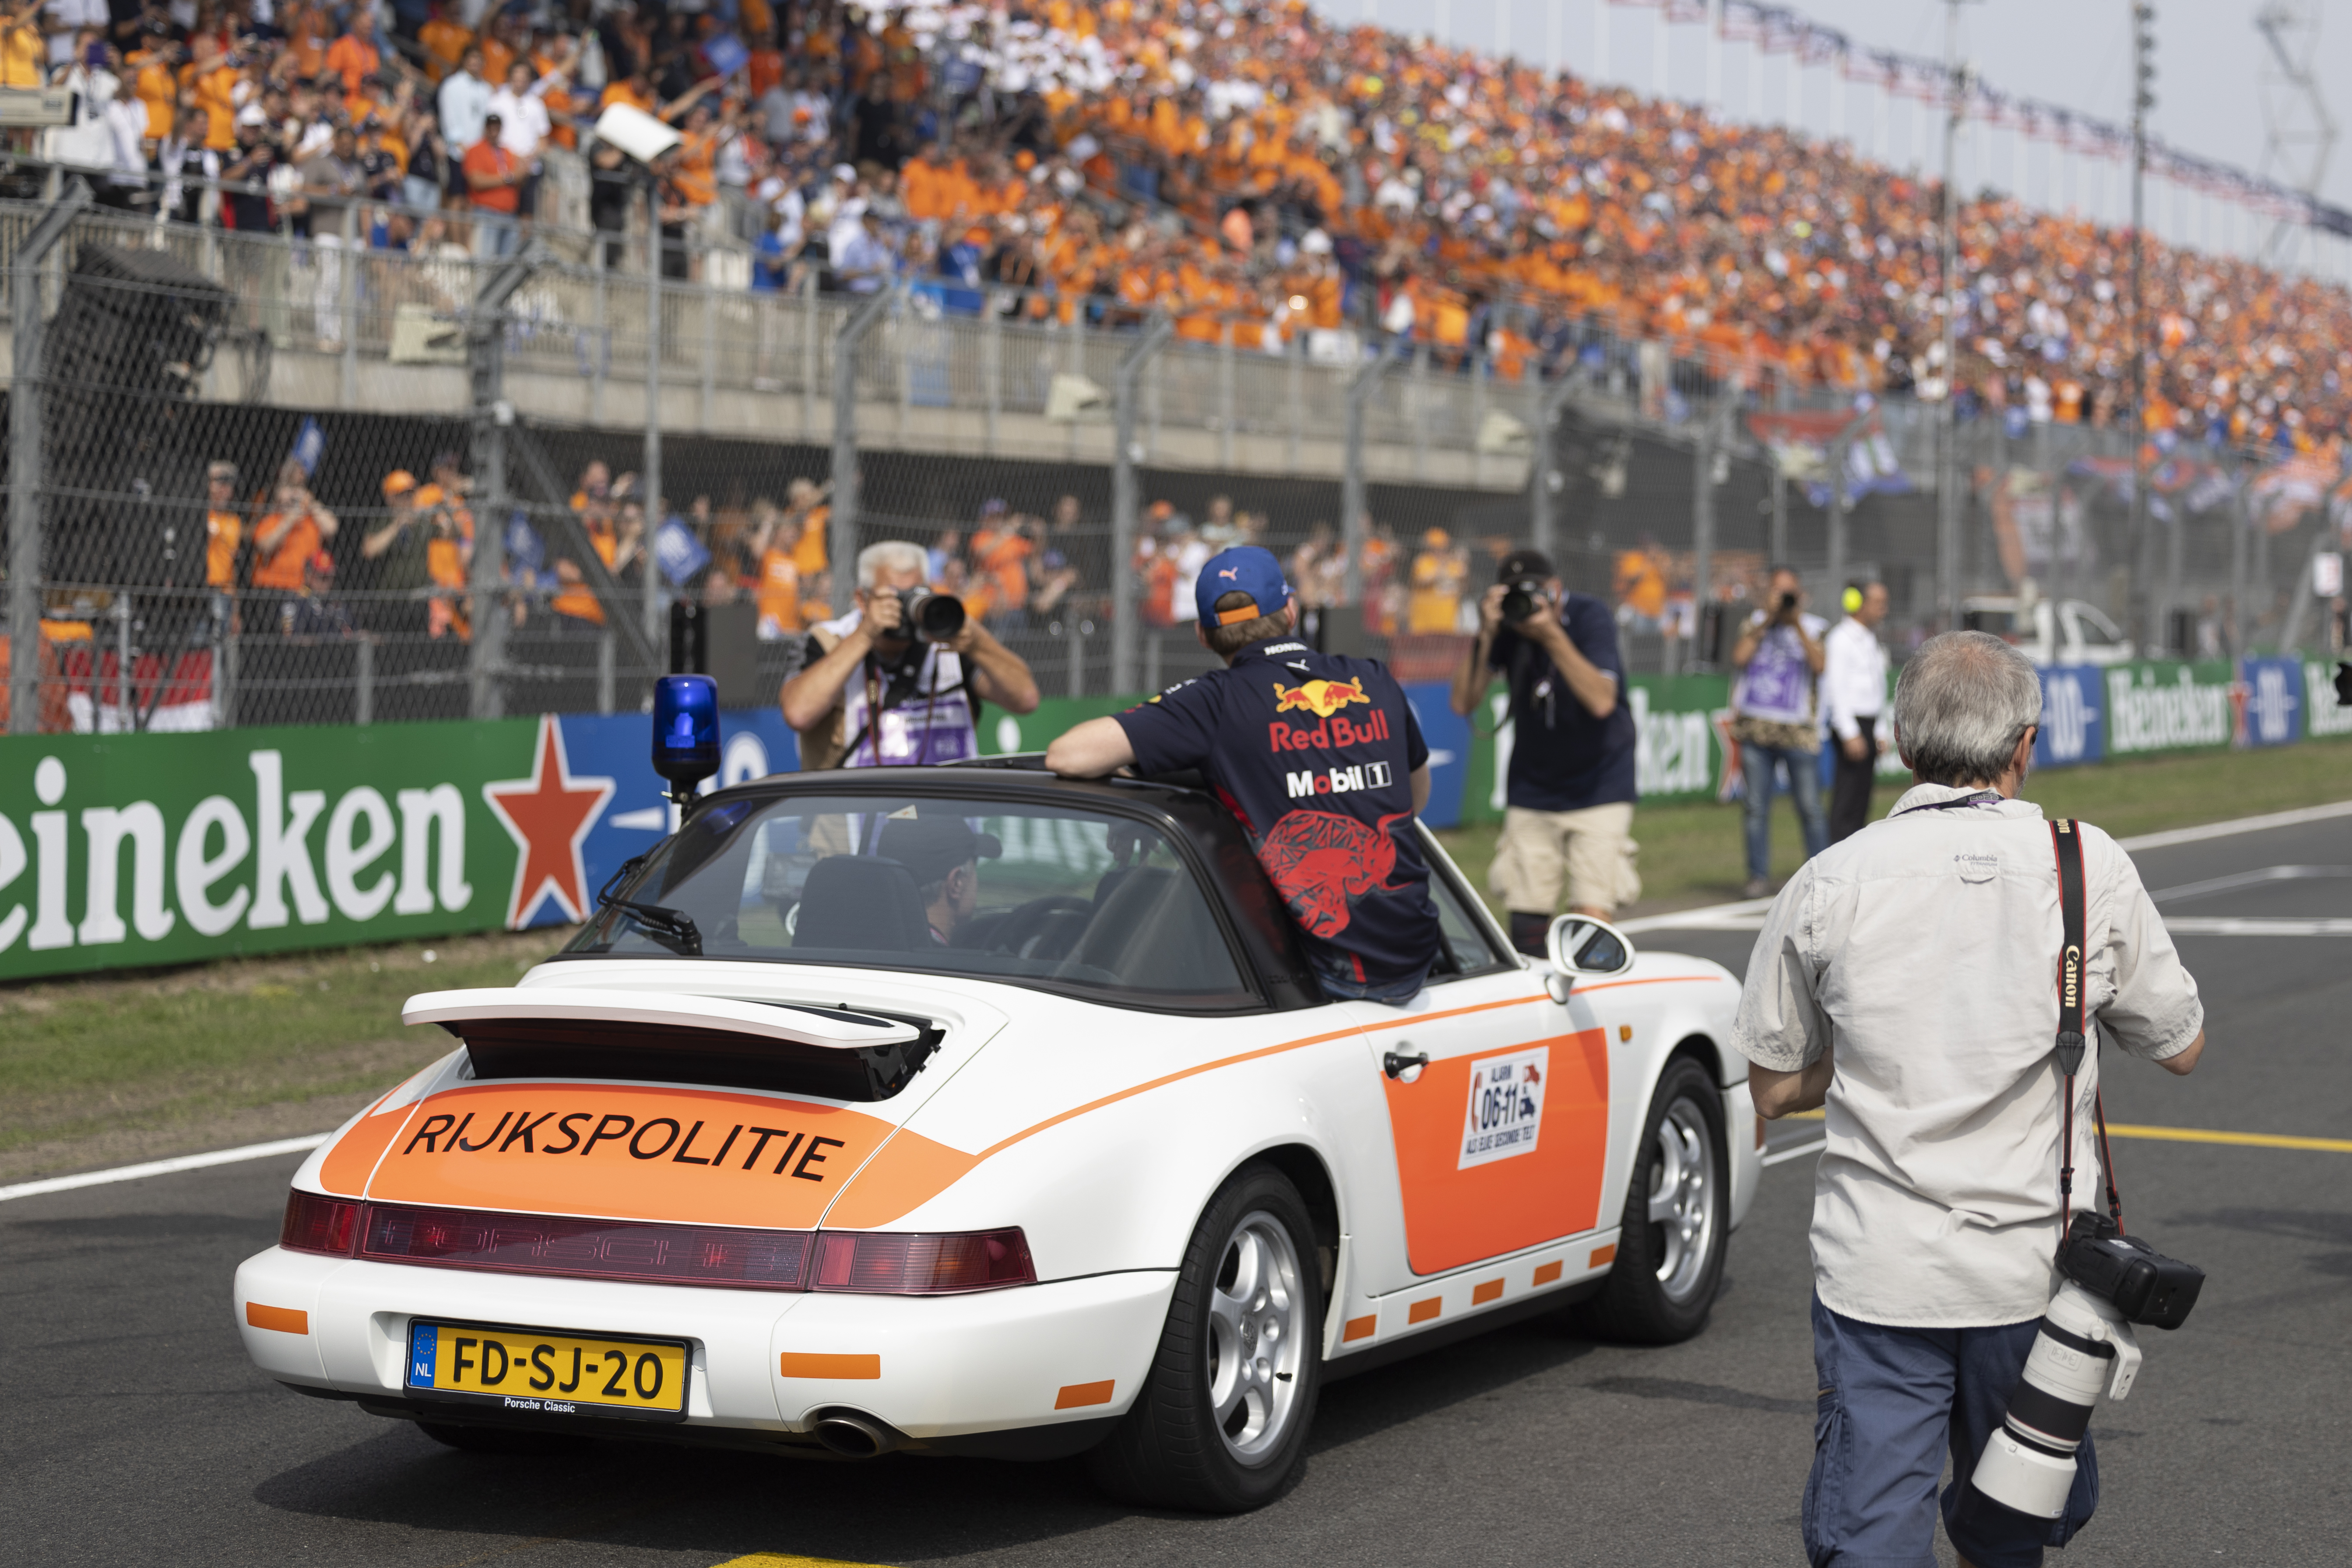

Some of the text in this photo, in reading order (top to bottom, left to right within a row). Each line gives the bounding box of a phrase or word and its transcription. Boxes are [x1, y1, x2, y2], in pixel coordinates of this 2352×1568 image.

[1263, 642, 1308, 656] HONDA
[1269, 709, 1389, 753] Red Bull
[1287, 763, 1387, 798] Mobil 1
[1970, 794, 1999, 802] 2022
[1962, 854, 1997, 862] Columbia
[2065, 945, 2080, 1008] Canon
[1491, 1064, 1513, 1083] ALARM
[1482, 1083, 1518, 1130] 06-11
[402, 1111, 845, 1182] RIJKSPOLITIE
[384, 1220, 778, 1269] PORSCHE
[415, 1362, 432, 1378] NL
[454, 1337, 663, 1399] FD-SJ-20
[504, 1397, 576, 1413] Porsche Classic
